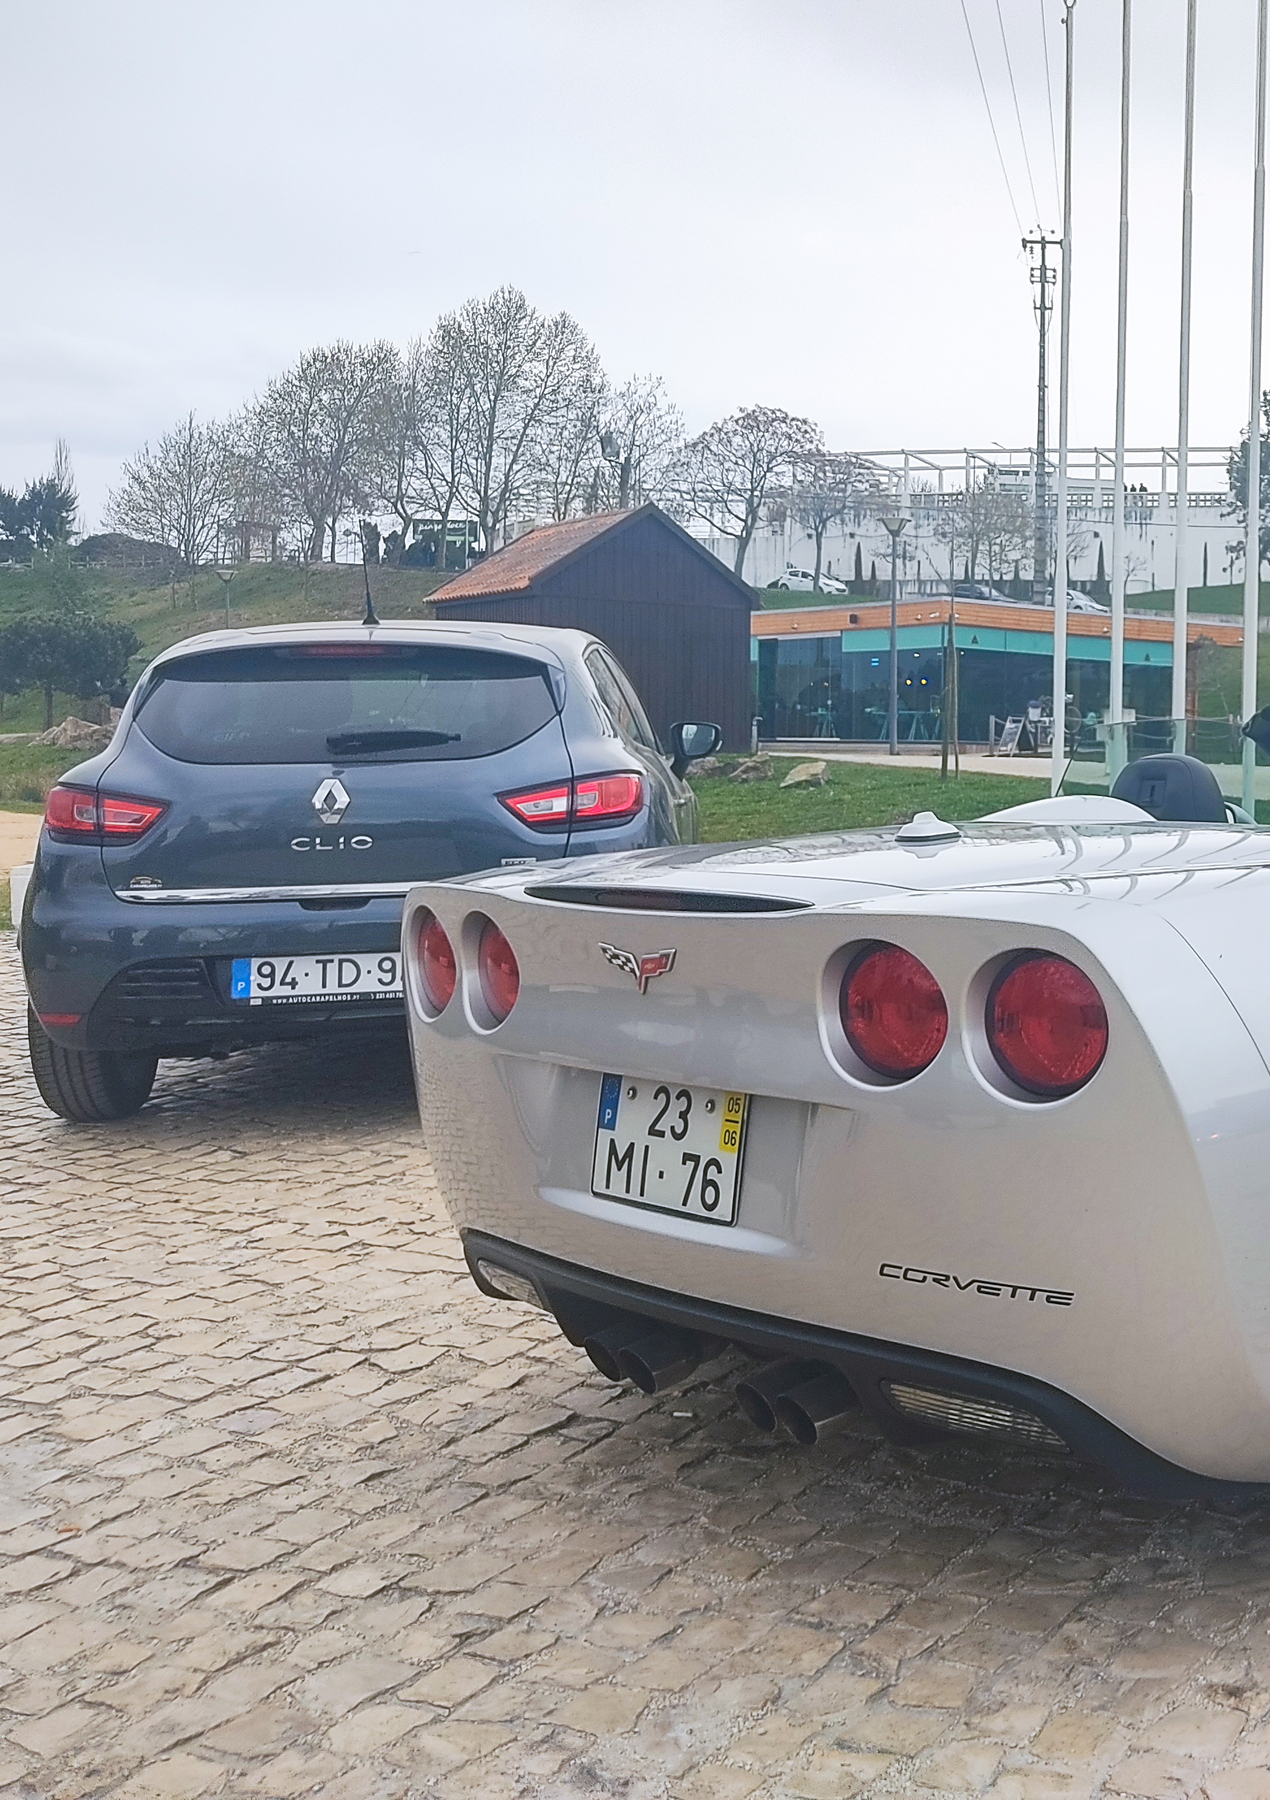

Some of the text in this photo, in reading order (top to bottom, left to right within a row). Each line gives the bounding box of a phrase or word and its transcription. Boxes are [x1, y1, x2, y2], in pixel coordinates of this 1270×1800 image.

[290, 835, 373, 851] CLIO
[237, 982, 246, 991] P
[647, 1085, 693, 1142] 23
[727, 1096, 741, 1114] 05
[604, 1108, 613, 1124] P
[723, 1129, 737, 1147] 06
[878, 1262, 1075, 1306] CORVETTE
